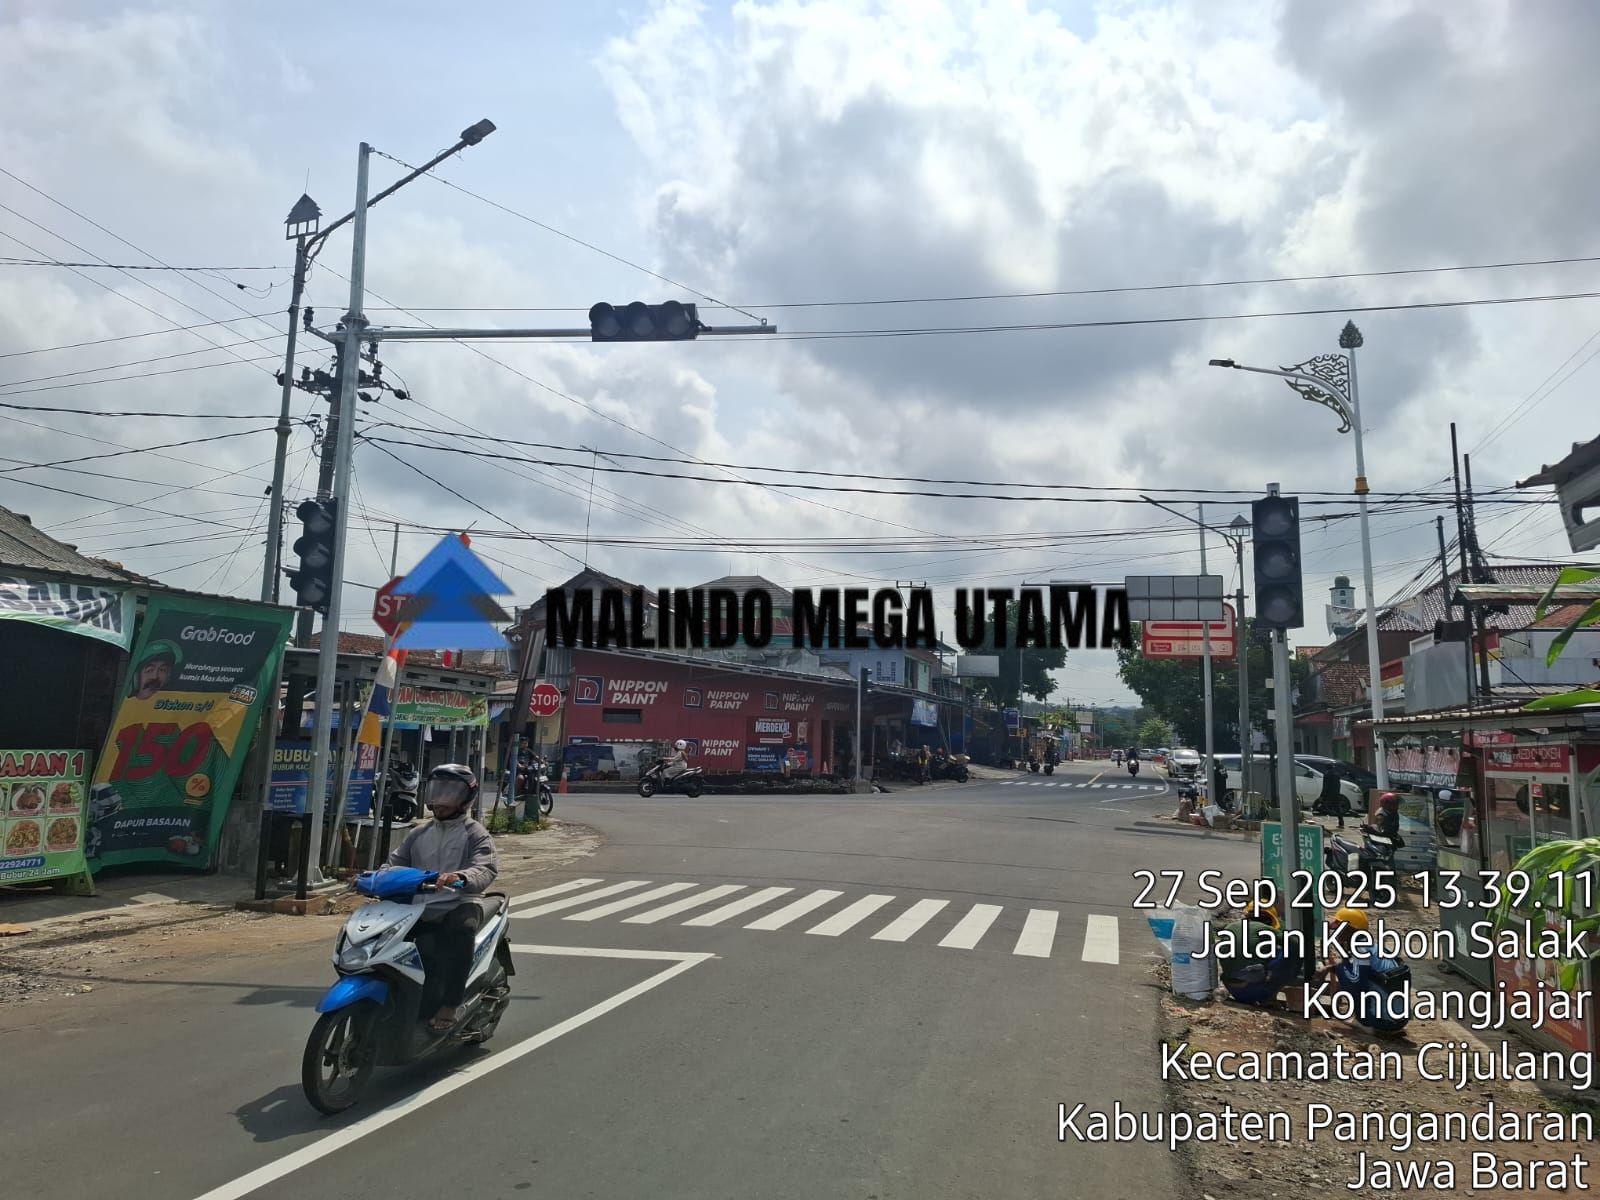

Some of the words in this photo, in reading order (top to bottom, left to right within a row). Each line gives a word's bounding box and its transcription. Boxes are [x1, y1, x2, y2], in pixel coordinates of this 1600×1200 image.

[180, 625, 256, 646] GrabFood
[608, 679, 668, 692] NIPPON
[530, 693, 559, 706] STOP
[611, 692, 658, 705] PAINT
[707, 690, 750, 701] NIPPON
[709, 701, 743, 710] PAINT
[784, 702, 810, 712] PAINT
[701, 739, 740, 749] NIPPON
[109, 721, 214, 781] 150
[273, 749, 312, 762] BUBU
[361, 743, 375, 759] 24
[704, 748, 734, 757] PAINT
[72, 752, 84, 776] 1
[359, 759, 374, 769] JAM
[114, 820, 145, 830] DAPUR
[146, 817, 192, 827] BASAJAN
